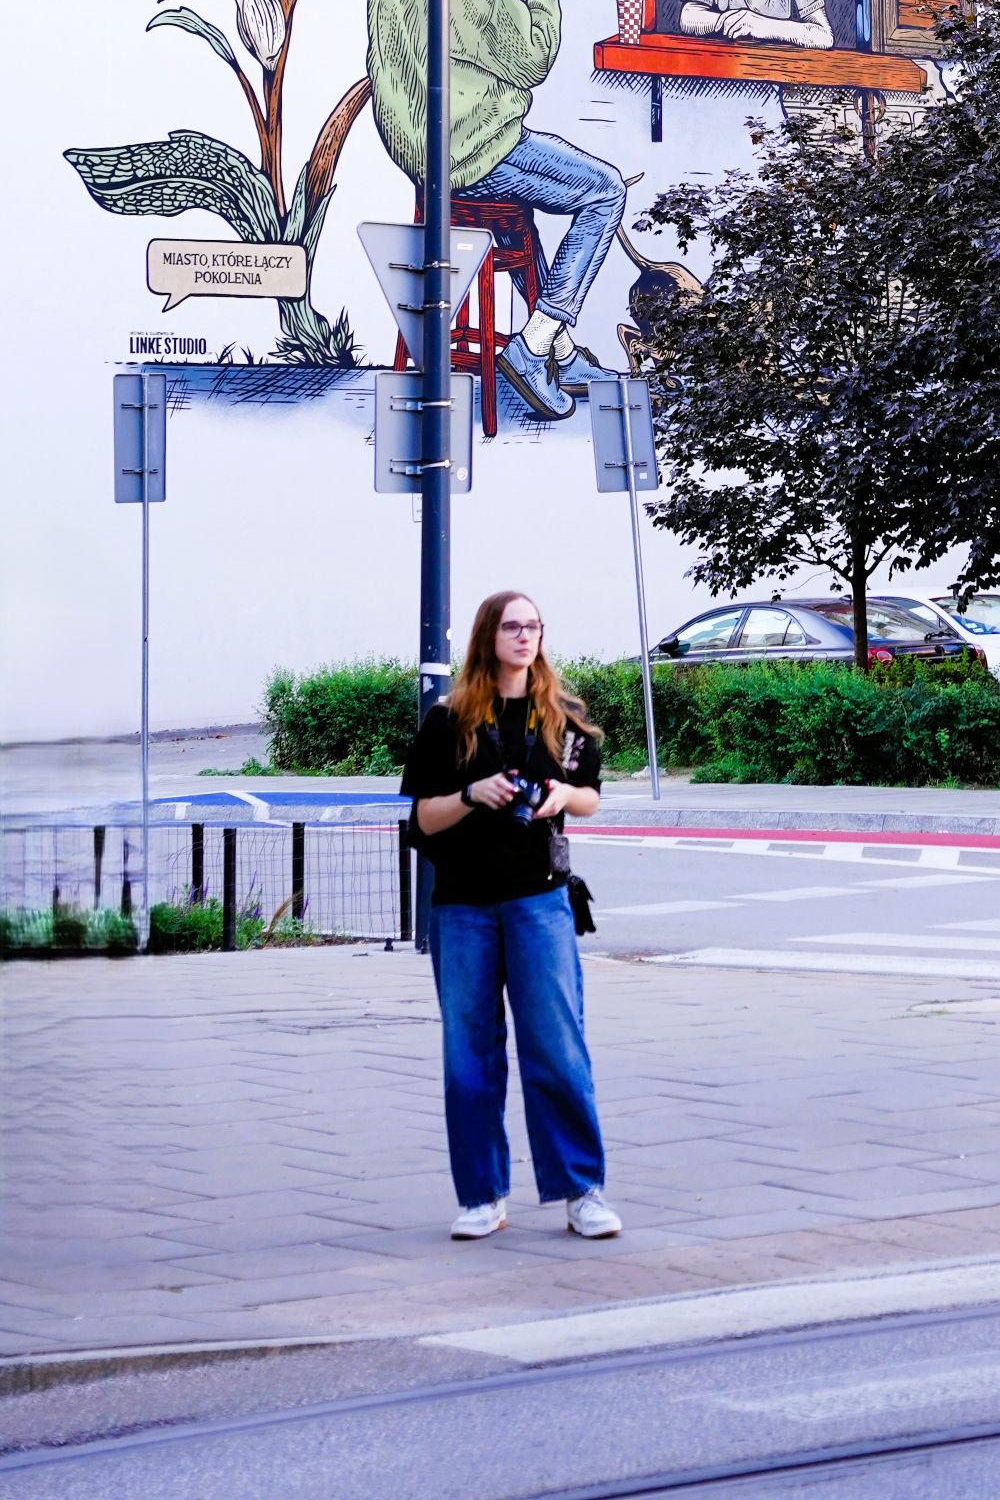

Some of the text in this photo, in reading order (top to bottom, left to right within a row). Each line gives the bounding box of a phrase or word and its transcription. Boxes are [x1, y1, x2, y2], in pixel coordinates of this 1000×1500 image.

[163, 251, 293, 272] MIASTO, KTÓRE ŁĄCZY
[194, 271, 262, 285] POKOLENIA
[129, 336, 207, 355] LINKE STUDIO
